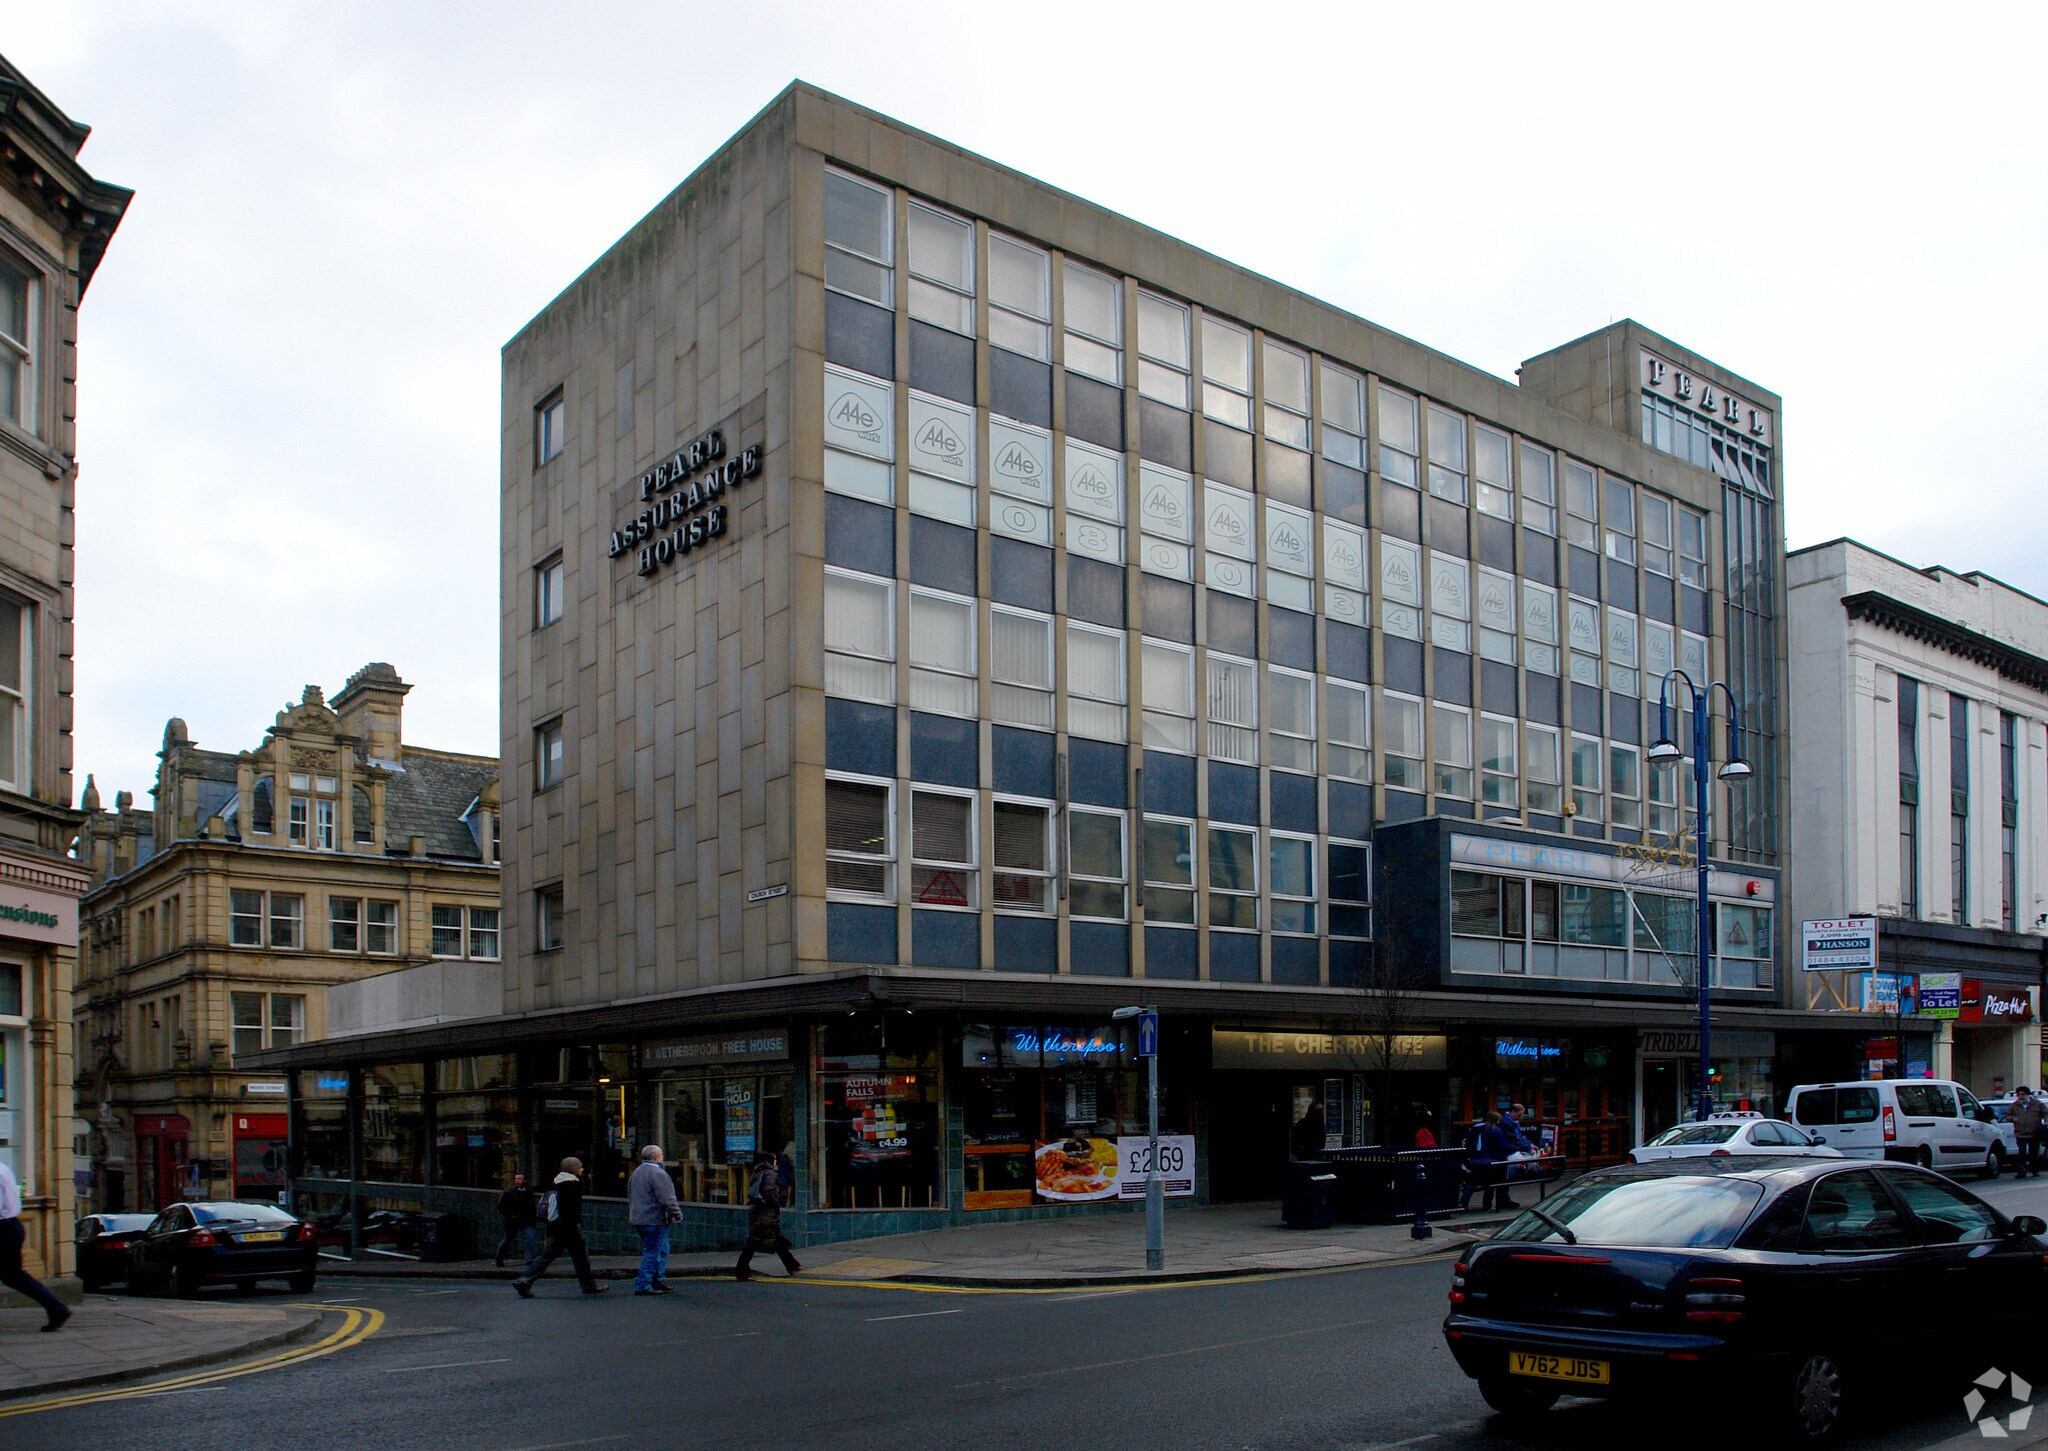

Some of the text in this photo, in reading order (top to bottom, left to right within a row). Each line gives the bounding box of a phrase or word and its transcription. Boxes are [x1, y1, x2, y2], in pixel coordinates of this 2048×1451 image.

[1649, 358, 1765, 436] PEARL
[836, 400, 873, 428] A4e
[858, 430, 881, 443] work
[922, 424, 957, 452] A4e
[640, 429, 726, 502] PEARL
[942, 455, 963, 467] work
[1001, 448, 1034, 474] A4e
[1077, 470, 1107, 495] A4e
[608, 441, 763, 558] ASSURANCE
[1149, 492, 1177, 515] A4e
[1214, 510, 1240, 533] A4e
[638, 505, 728, 577] HOUSE
[1274, 528, 1299, 551] A4e
[1332, 545, 1356, 566] A4e
[1387, 562, 1409, 582] A4e
[1482, 842, 1597, 874] PEARL
[1839, 920, 1867, 928] LET
[1822, 940, 1867, 949] HANSON
[1808, 956, 1835, 964] 01484
[1921, 999, 1936, 1008] To
[1939, 998, 1958, 1007] Let
[1984, 994, 2028, 1016] Pizza Hut
[723, 1040, 746, 1055] FREE
[749, 1037, 783, 1053] HOUSE
[1245, 1034, 1284, 1053] THE
[1294, 1036, 1368, 1055] CHERRY
[846, 1078, 892, 1088] AUTUMN
[846, 1087, 874, 1097] FALLS
[726, 1091, 751, 1106] HOLD
[879, 1138, 908, 1147] £4.99
[1517, 1354, 1600, 1379] V762 JDS
